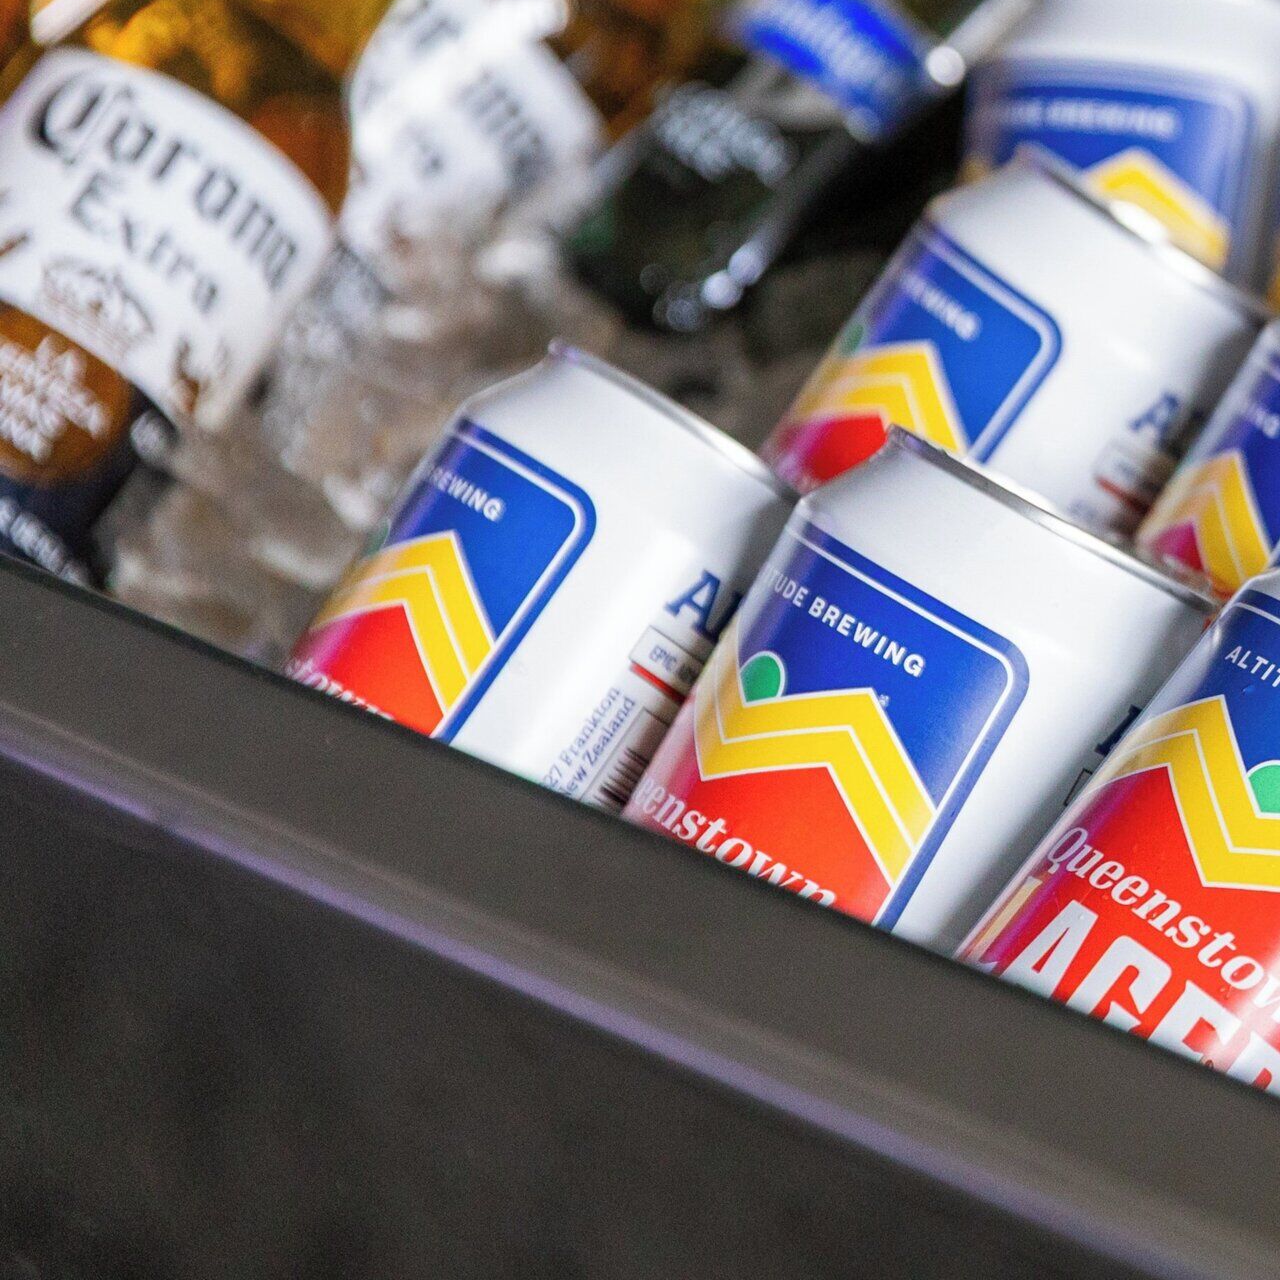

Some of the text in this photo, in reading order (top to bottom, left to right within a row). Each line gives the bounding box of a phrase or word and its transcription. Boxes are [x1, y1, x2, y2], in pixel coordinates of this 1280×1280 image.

[26, 68, 299, 294] Corona
[70, 167, 221, 317] Extra
[808, 595, 926, 678] BREWING
[559, 686, 622, 767] Frankton
[584, 696, 636, 767] Zealand
